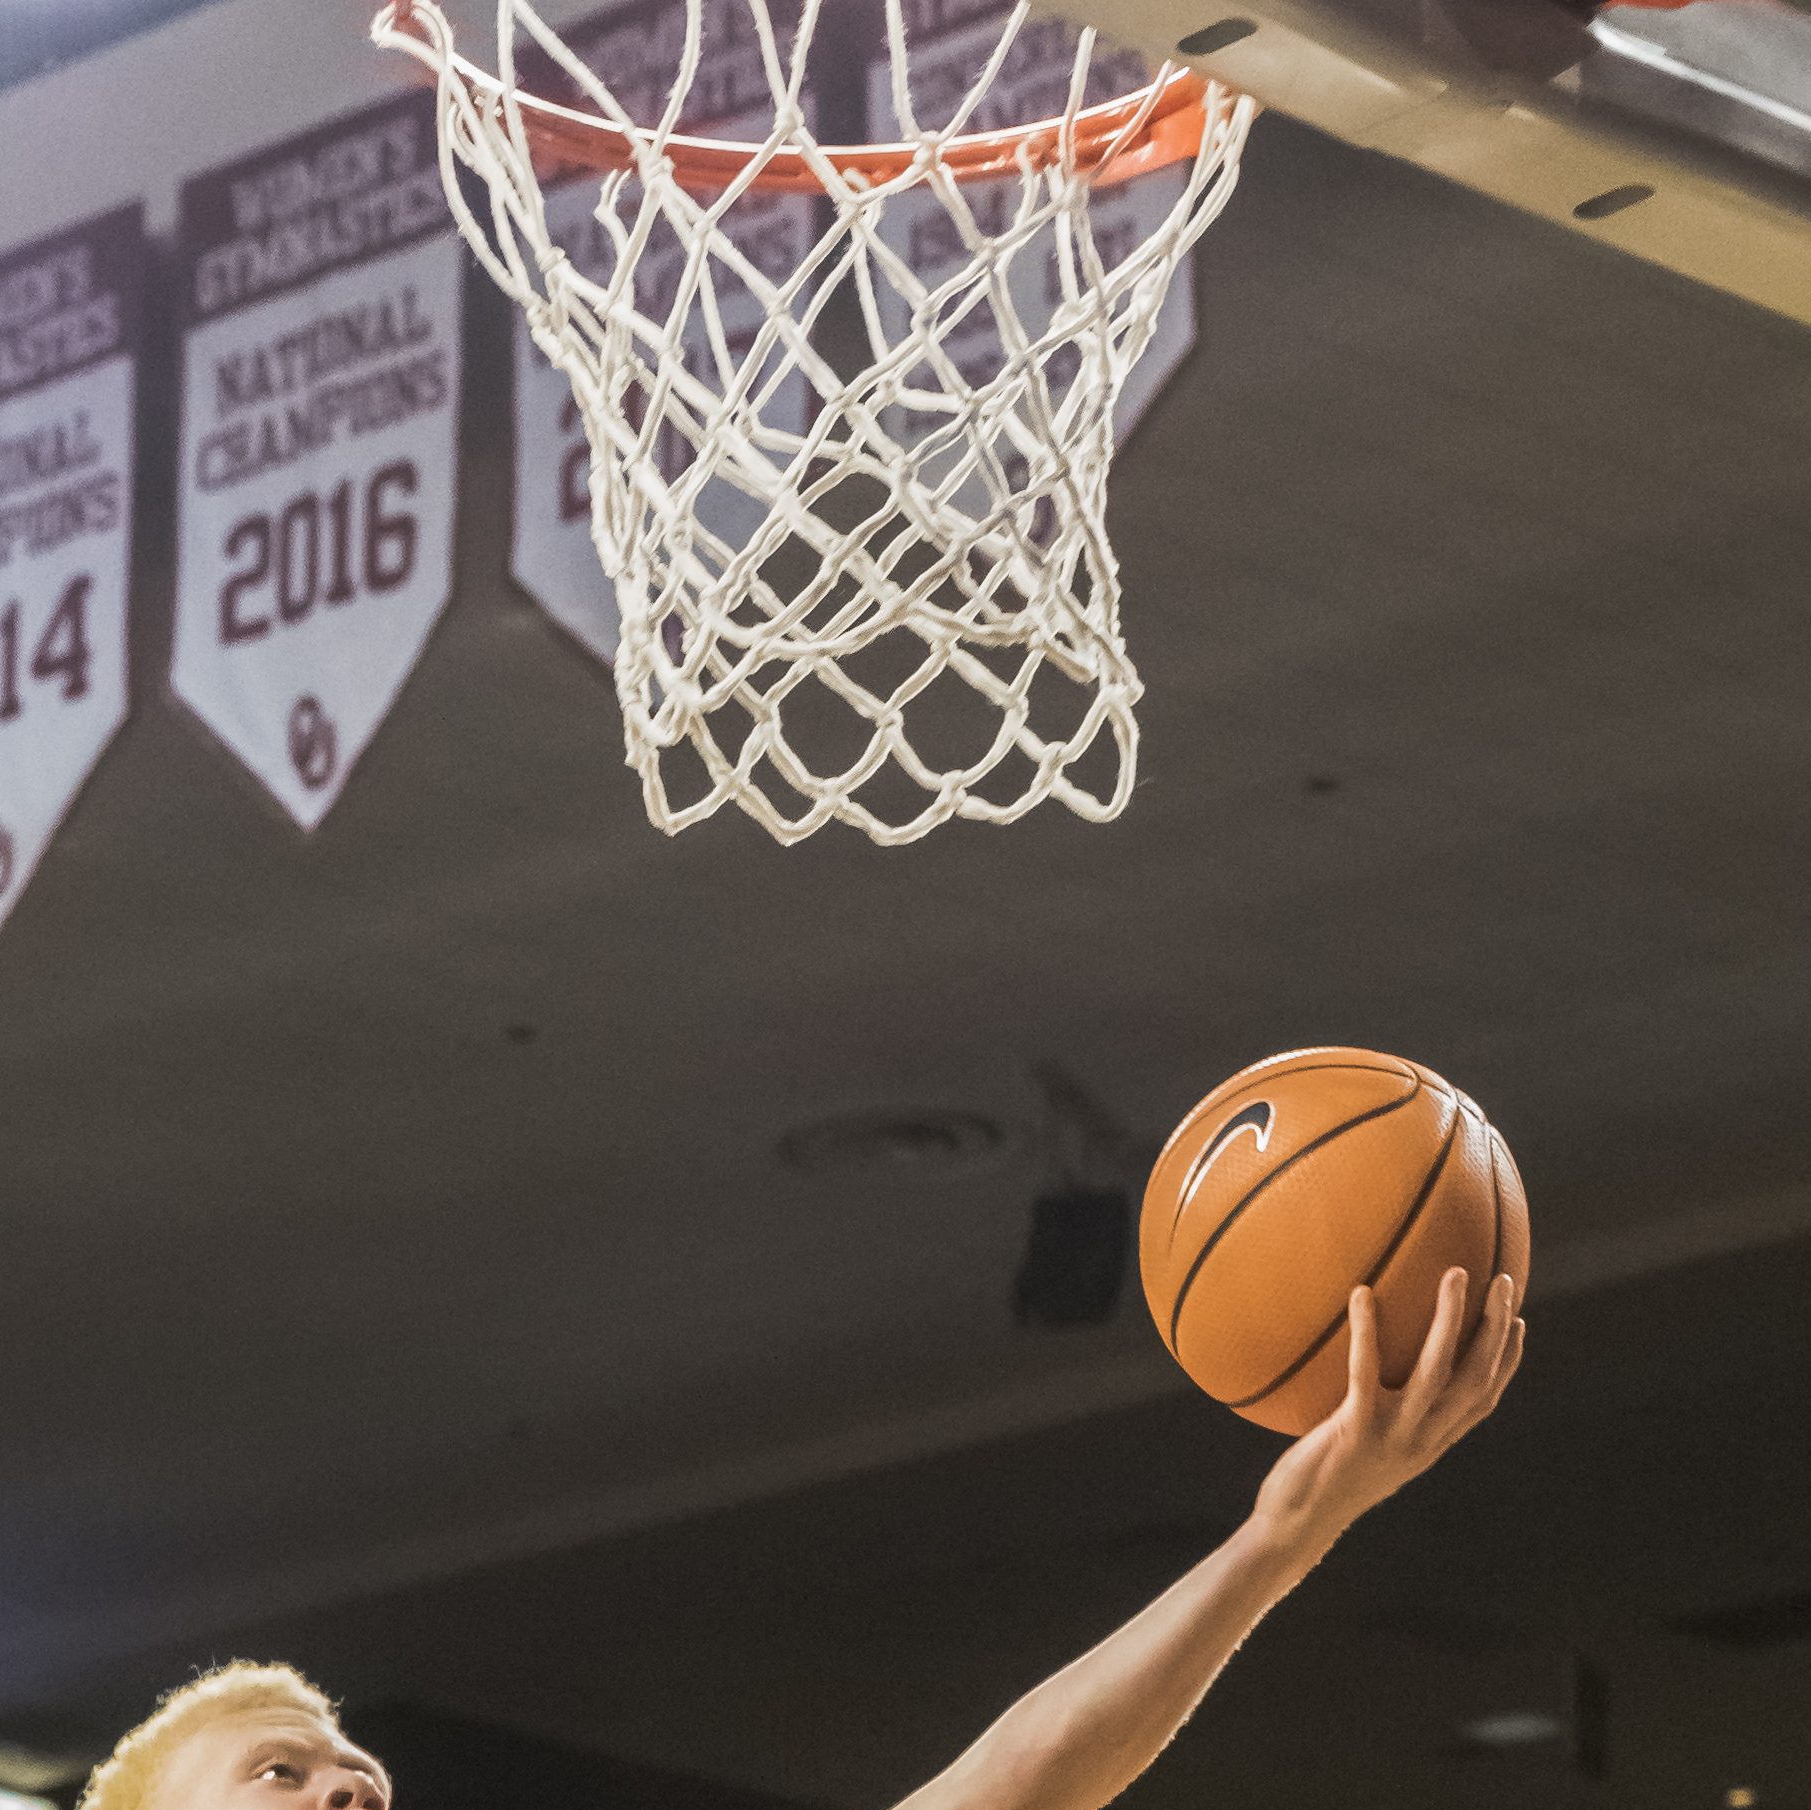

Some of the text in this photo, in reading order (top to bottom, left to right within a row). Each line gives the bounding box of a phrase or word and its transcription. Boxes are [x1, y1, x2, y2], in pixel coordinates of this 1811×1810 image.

[213, 286, 436, 408] NATIONAL
[196, 357, 449, 493] CHAMPIONS
[219, 458, 419, 646] 2016
